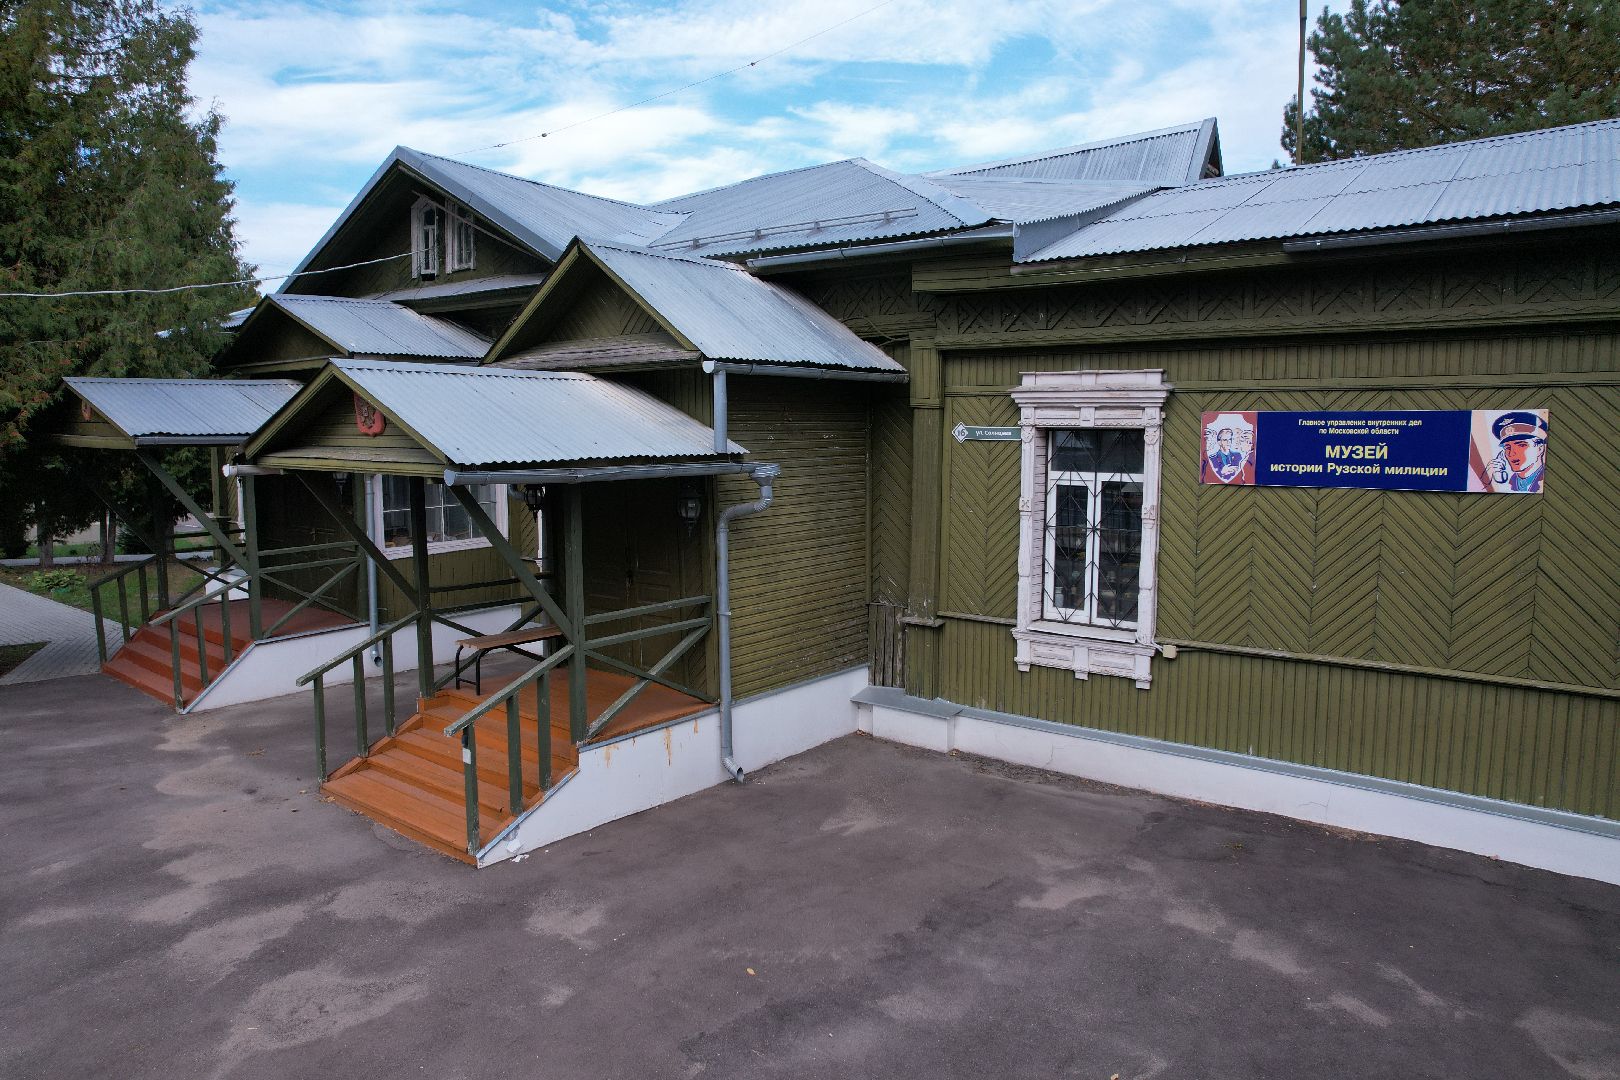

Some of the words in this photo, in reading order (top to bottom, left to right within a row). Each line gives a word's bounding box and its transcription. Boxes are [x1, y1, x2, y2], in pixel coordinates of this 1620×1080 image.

[1298, 418, 1326, 426] Главное
[1326, 419, 1366, 427] управление
[1367, 419, 1407, 427] внутренних
[1408, 419, 1423, 427] дел
[1328, 427, 1370, 435] Московской
[1370, 427, 1400, 436] области
[1325, 442, 1389, 460] МУЗЕЙ
[1270, 463, 1323, 474] истории
[1327, 462, 1381, 475] Рузской
[1384, 466, 1448, 477] милиции
